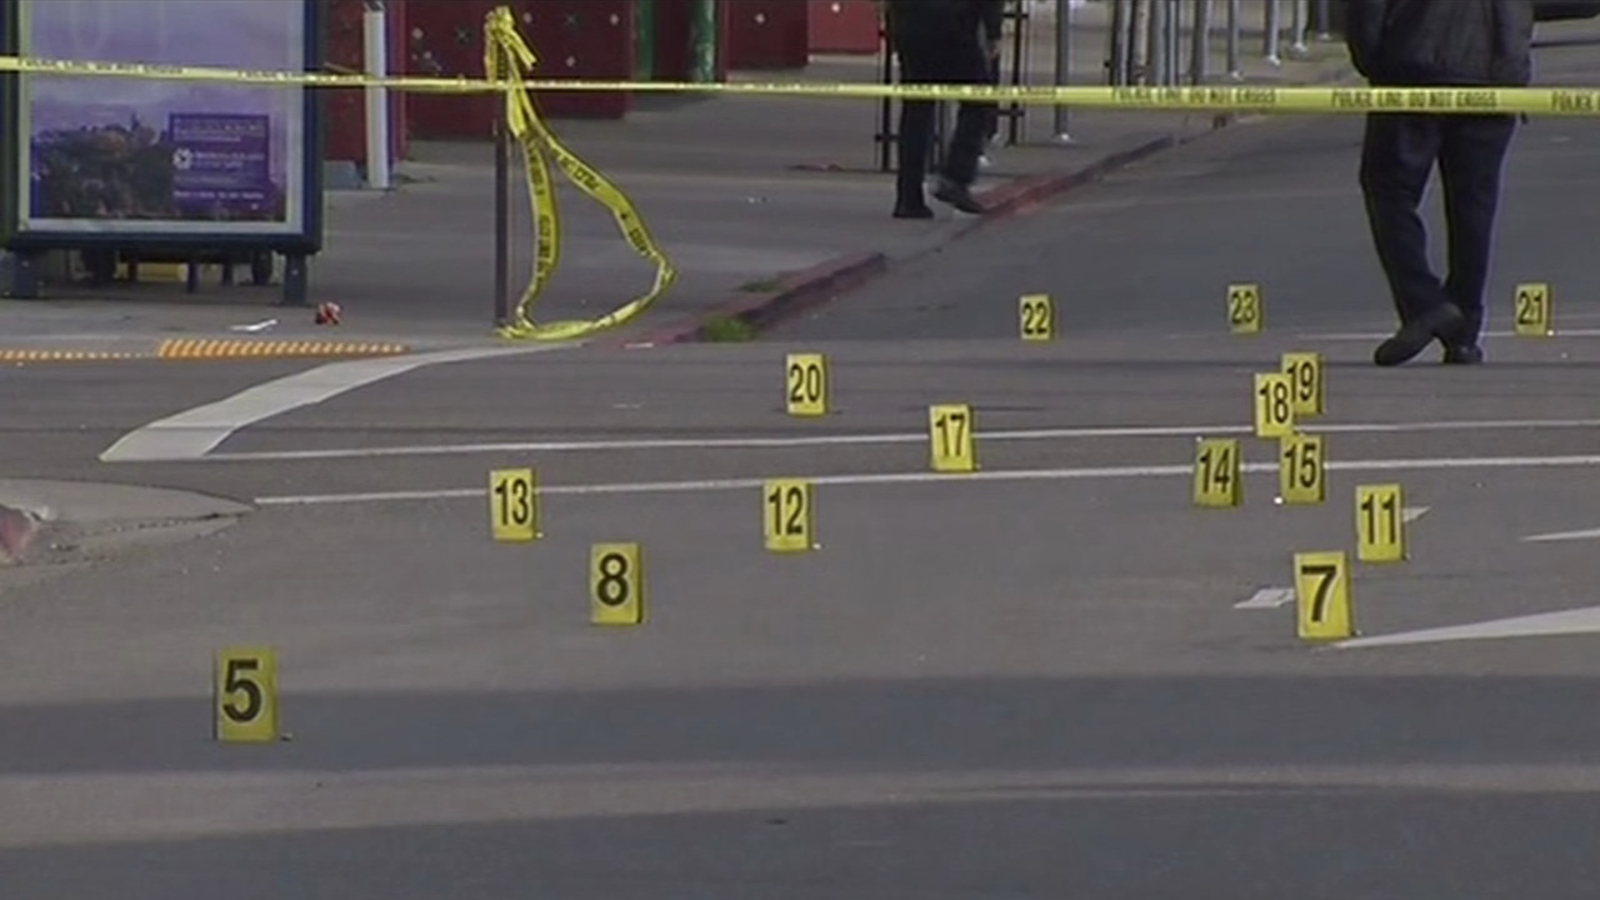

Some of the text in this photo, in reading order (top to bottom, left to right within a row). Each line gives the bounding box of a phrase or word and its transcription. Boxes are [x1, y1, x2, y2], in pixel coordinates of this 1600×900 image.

[1331, 90, 1497, 107] POLICE LINE DO NOT CROSS
[1551, 91, 1593, 111] POLICE
[1022, 302, 1048, 335] 22
[1230, 291, 1256, 325] 23
[1518, 291, 1543, 325] 21
[789, 364, 821, 403] 20
[1260, 382, 1288, 424] 18
[1287, 362, 1314, 402] 19
[935, 414, 965, 457] 17
[1200, 448, 1231, 494] 14
[1284, 443, 1317, 488] 15
[495, 479, 529, 526] 13
[769, 487, 803, 535] 12
[1361, 493, 1396, 545] 11
[597, 553, 629, 606] 8
[1301, 565, 1336, 622] 7
[222, 658, 262, 723] 5
